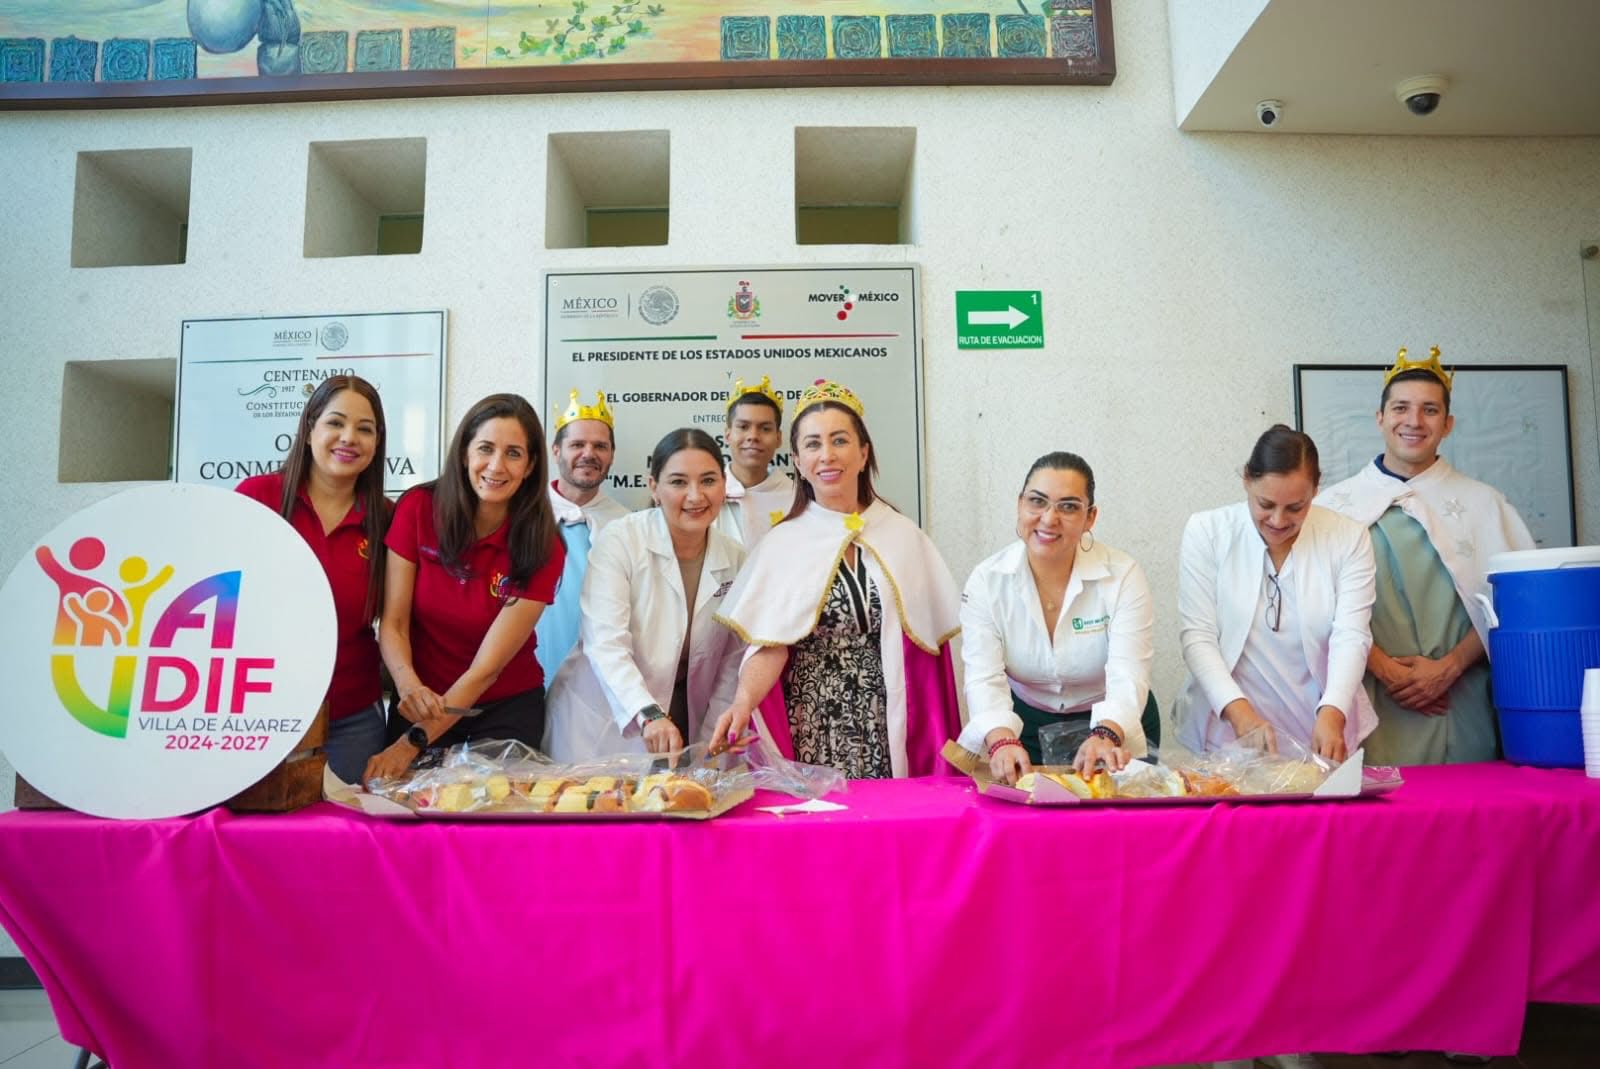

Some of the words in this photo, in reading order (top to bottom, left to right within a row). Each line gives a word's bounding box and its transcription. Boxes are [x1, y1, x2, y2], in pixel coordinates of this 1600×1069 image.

[563, 296, 617, 309] MÉXICO
[808, 293, 845, 302] MOVER
[858, 291, 899, 301] MÉXICO
[1030, 293, 1037, 305] 1
[273, 329, 312, 340] MÉXICO
[959, 335, 979, 345] RUTA
[981, 335, 991, 345] DE
[993, 335, 1042, 345] EVACUACION
[572, 352, 585, 362] EL
[588, 350, 659, 362] PRESIDENTE
[662, 350, 677, 361] DE
[680, 349, 702, 360] LOS
[706, 348, 761, 360] ESTADOS
[764, 348, 811, 359] UNIDOS
[814, 347, 887, 358] MEXICANOS
[264, 367, 355, 383] CENTENARIO
[727, 371, 733, 379] Y
[607, 393, 620, 403] EL
[622, 391, 708, 403] GOBERNADOR
[140, 655, 275, 714] DIF
[138, 717, 187, 731] VILLA
[192, 718, 217, 731] DE
[221, 715, 302, 733] ÁLVAREZ
[165, 734, 270, 750] 2024-2027
